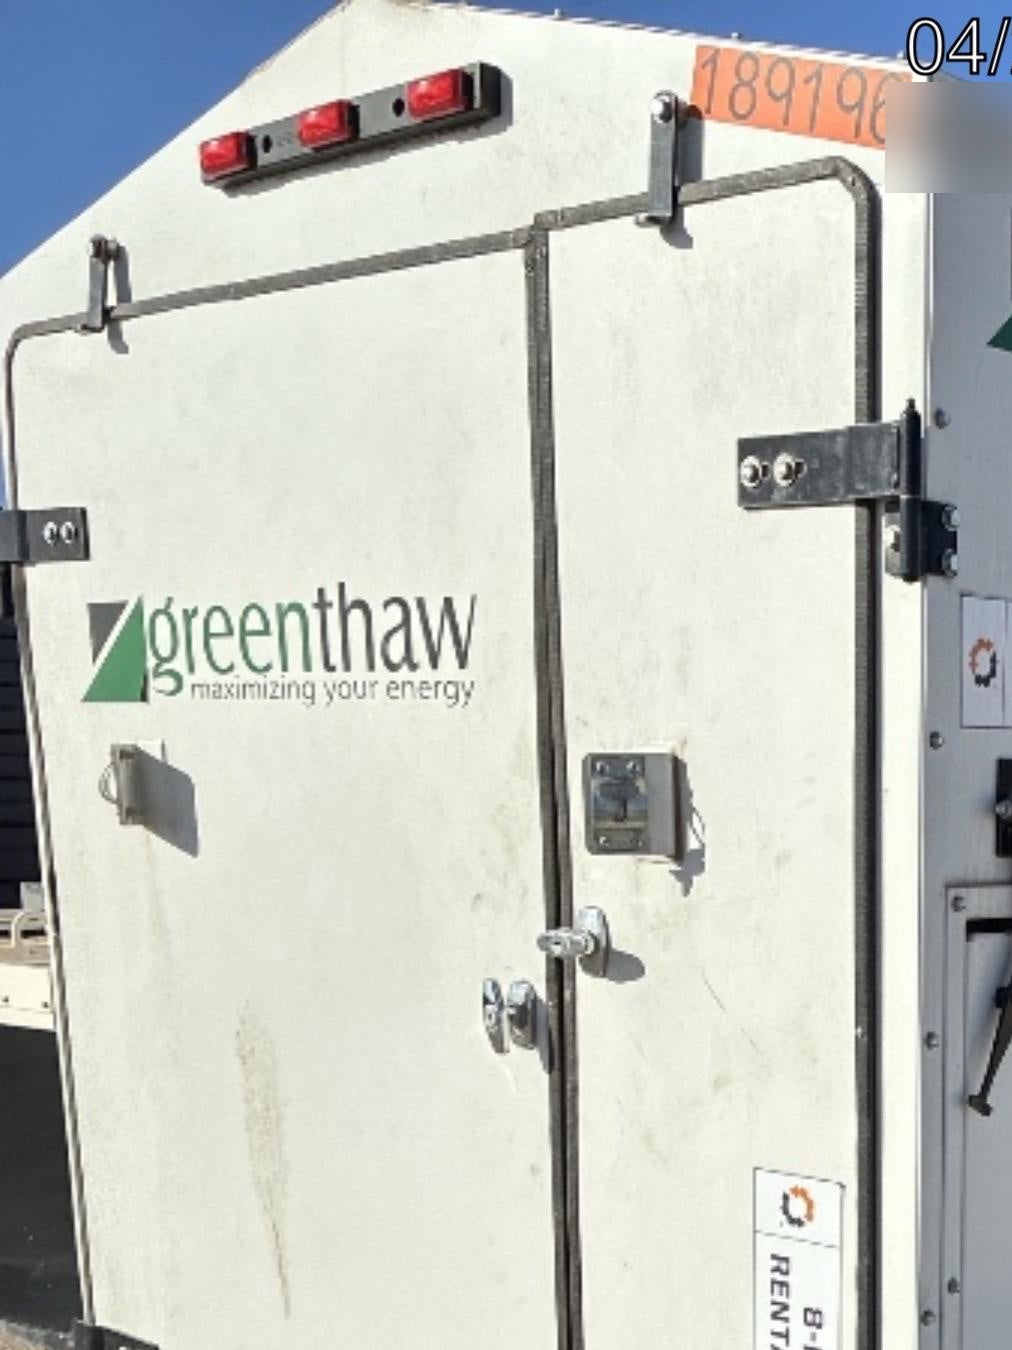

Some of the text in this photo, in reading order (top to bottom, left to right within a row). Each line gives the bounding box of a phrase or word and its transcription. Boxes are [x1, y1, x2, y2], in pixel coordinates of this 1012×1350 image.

[148, 581, 477, 697] greenthaw
[190, 675, 475, 708] maximizing your energy
